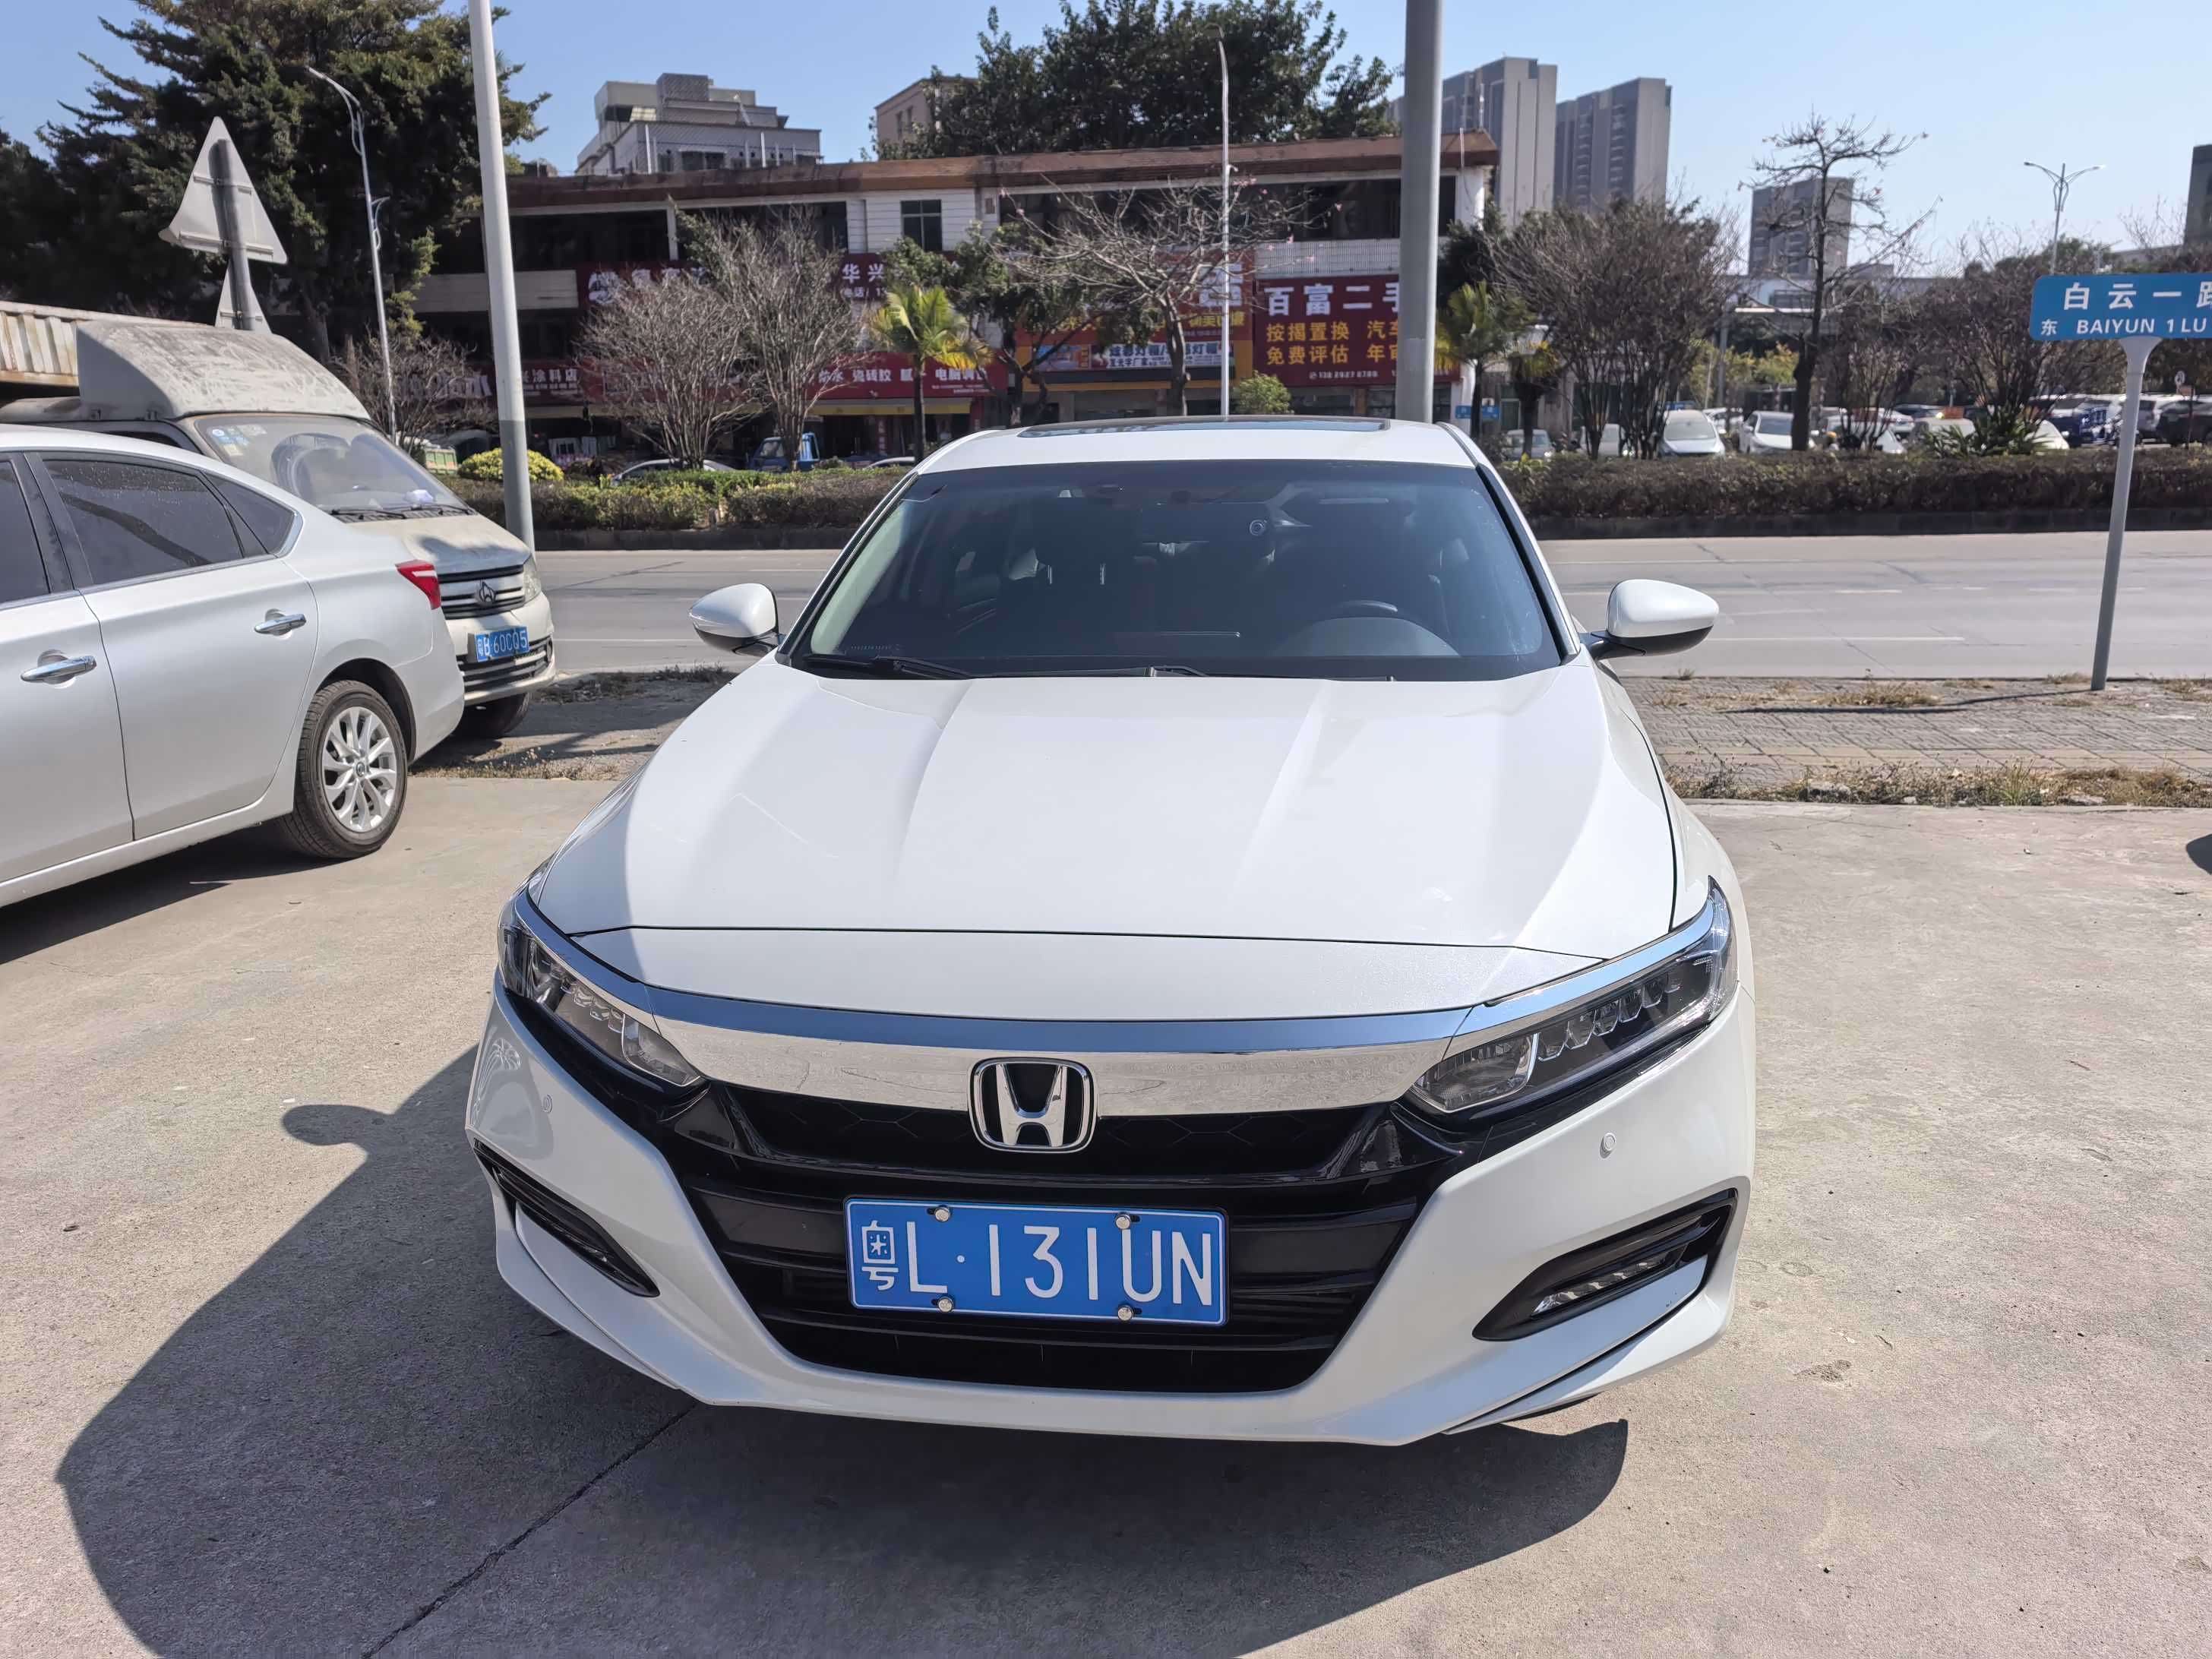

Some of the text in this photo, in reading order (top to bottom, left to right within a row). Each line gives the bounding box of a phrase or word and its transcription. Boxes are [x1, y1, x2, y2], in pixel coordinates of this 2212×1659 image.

[842, 263, 884, 283] 华兴
[1266, 321, 1350, 342] 按揭置换
[2041, 319, 2058, 336] 东
[2076, 318, 2155, 334] BAIYUN
[1266, 345, 1349, 365] 免费评估
